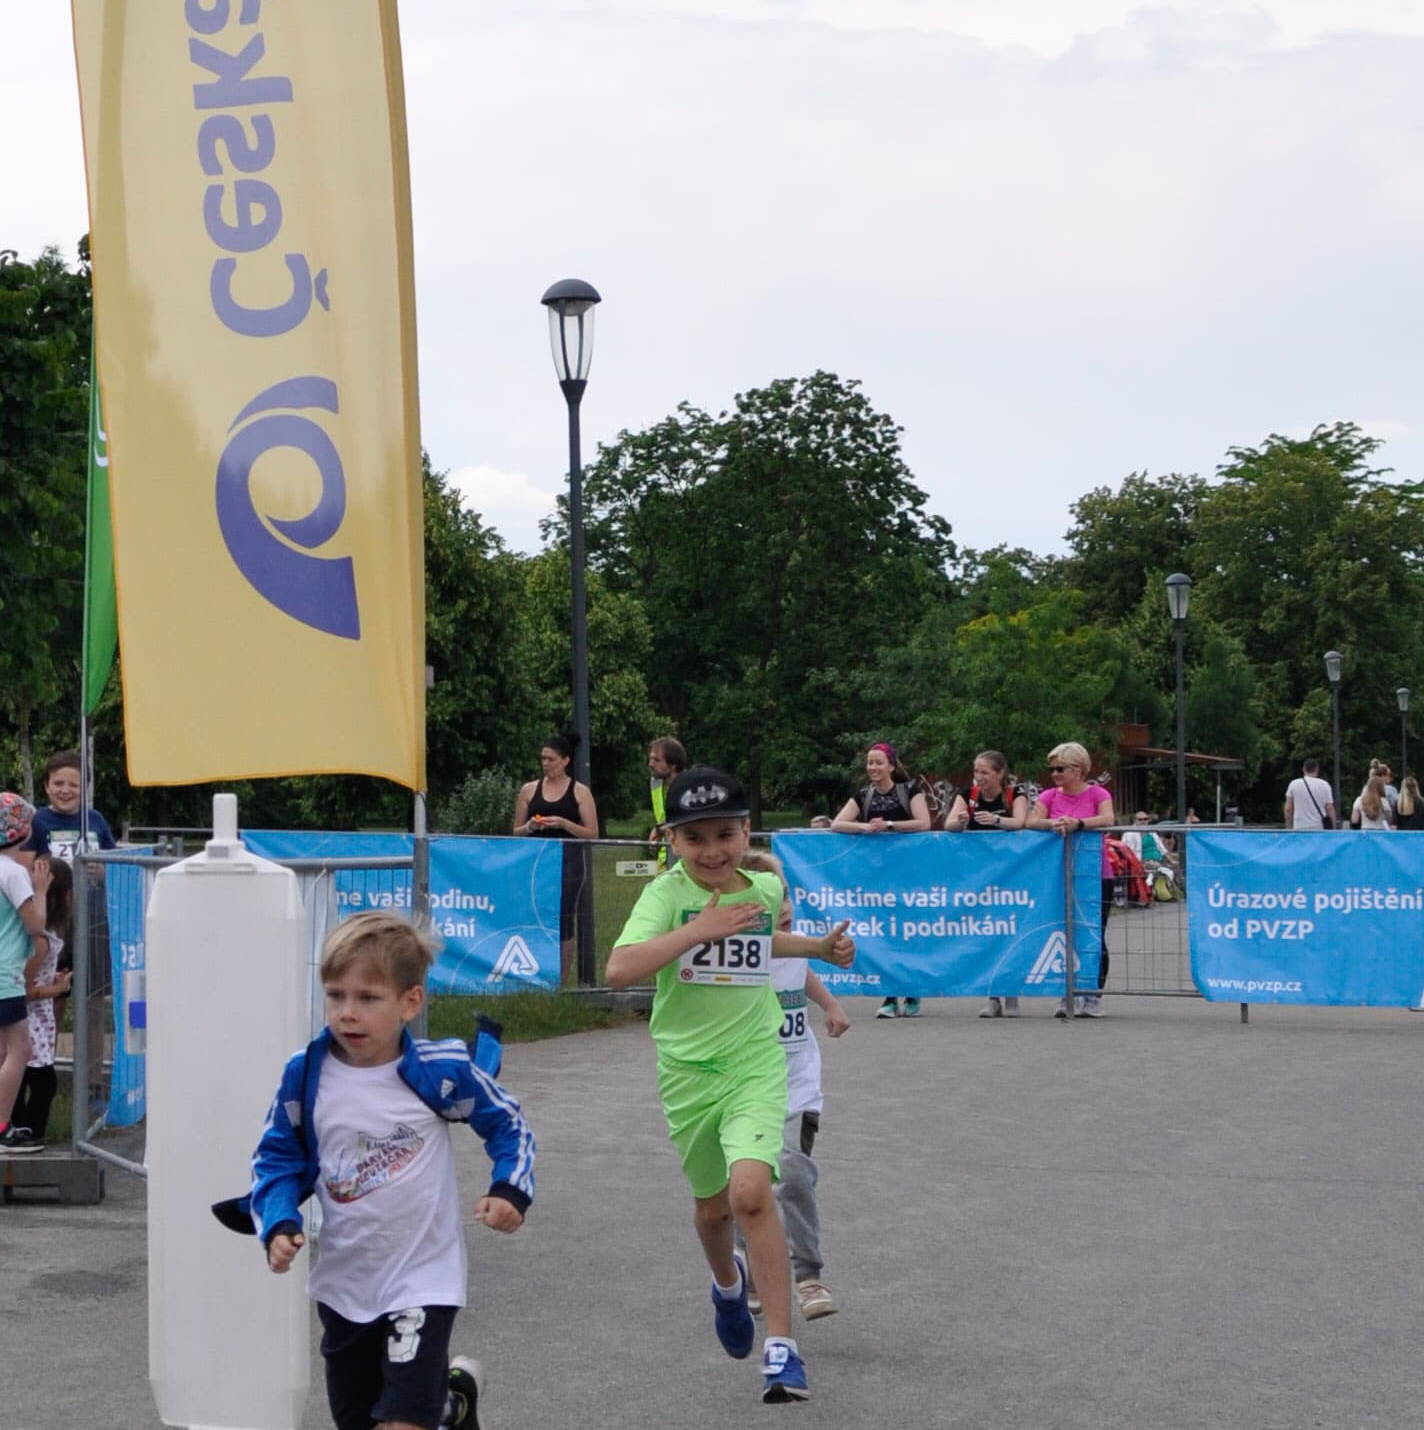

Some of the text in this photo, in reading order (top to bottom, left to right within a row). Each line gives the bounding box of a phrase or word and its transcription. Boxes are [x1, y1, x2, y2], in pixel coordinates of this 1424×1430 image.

[367, 886, 412, 908] vaši
[423, 888, 495, 913] odinu,
[794, 886, 1035, 911] Pojistíme vaši rodinu,
[1208, 883, 1424, 914] Úrazové pojištění
[890, 916, 897, 937] i
[903, 915, 1017, 941] podnikání
[1208, 918, 1314, 940] od PVZP
[692, 939, 761, 968] 2138
[1207, 977, 1303, 993] www.pvzp.cz
[388, 1307, 426, 1362] 3
